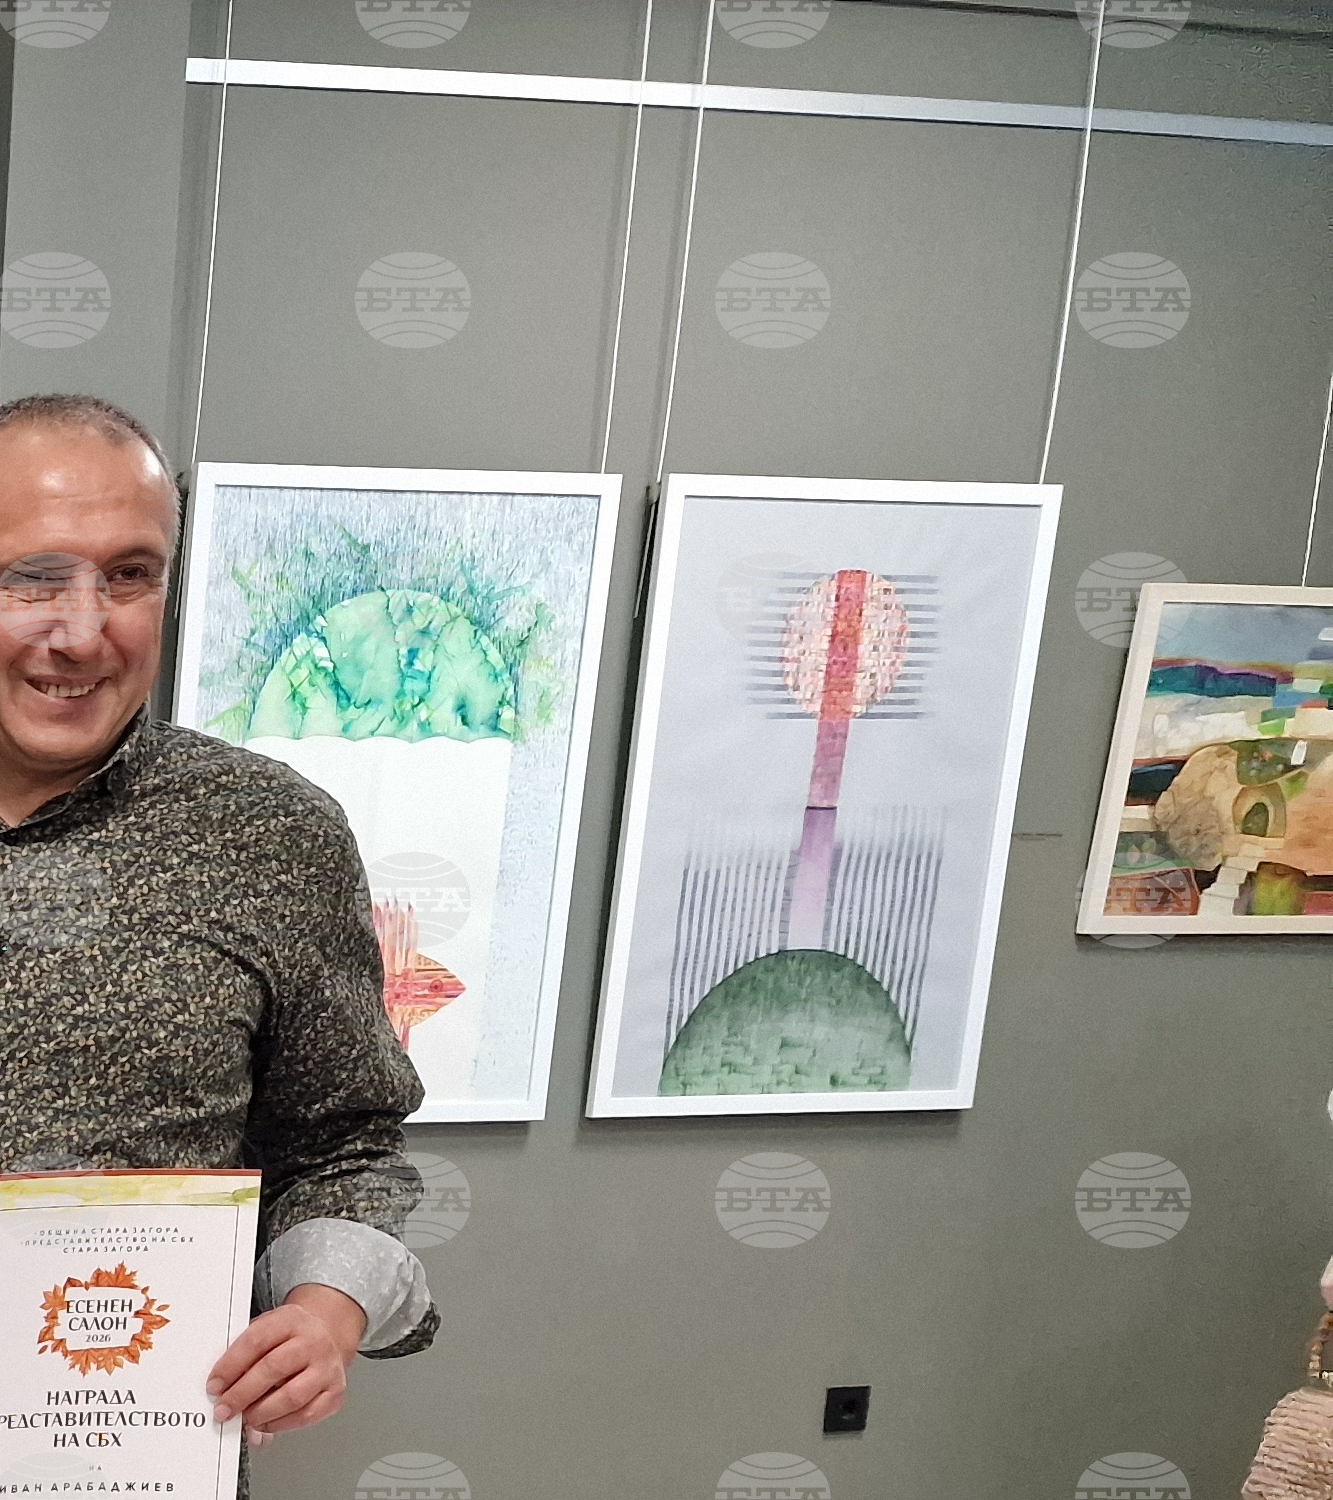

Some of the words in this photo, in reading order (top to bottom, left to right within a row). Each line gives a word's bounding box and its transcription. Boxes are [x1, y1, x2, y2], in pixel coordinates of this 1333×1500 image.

[90, 1227, 128, 1235] СТАРА
[133, 1226, 179, 1234] ЗАГОРА
[62, 1246, 99, 1254] СТАРА
[103, 1245, 149, 1253] ЗАГОРА
[65, 1298, 133, 1314] ЕСЕНЕН
[68, 1316, 128, 1331] САЛОН
[85, 1333, 111, 1343] 2026
[46, 1389, 137, 1406] НАГРАДА
[53, 1432, 80, 1448] НА
[85, 1432, 123, 1448] СБХ
[0, 1483, 43, 1494] ИВАН
[50, 1481, 175, 1493] АРАБАДЖИЕВ
